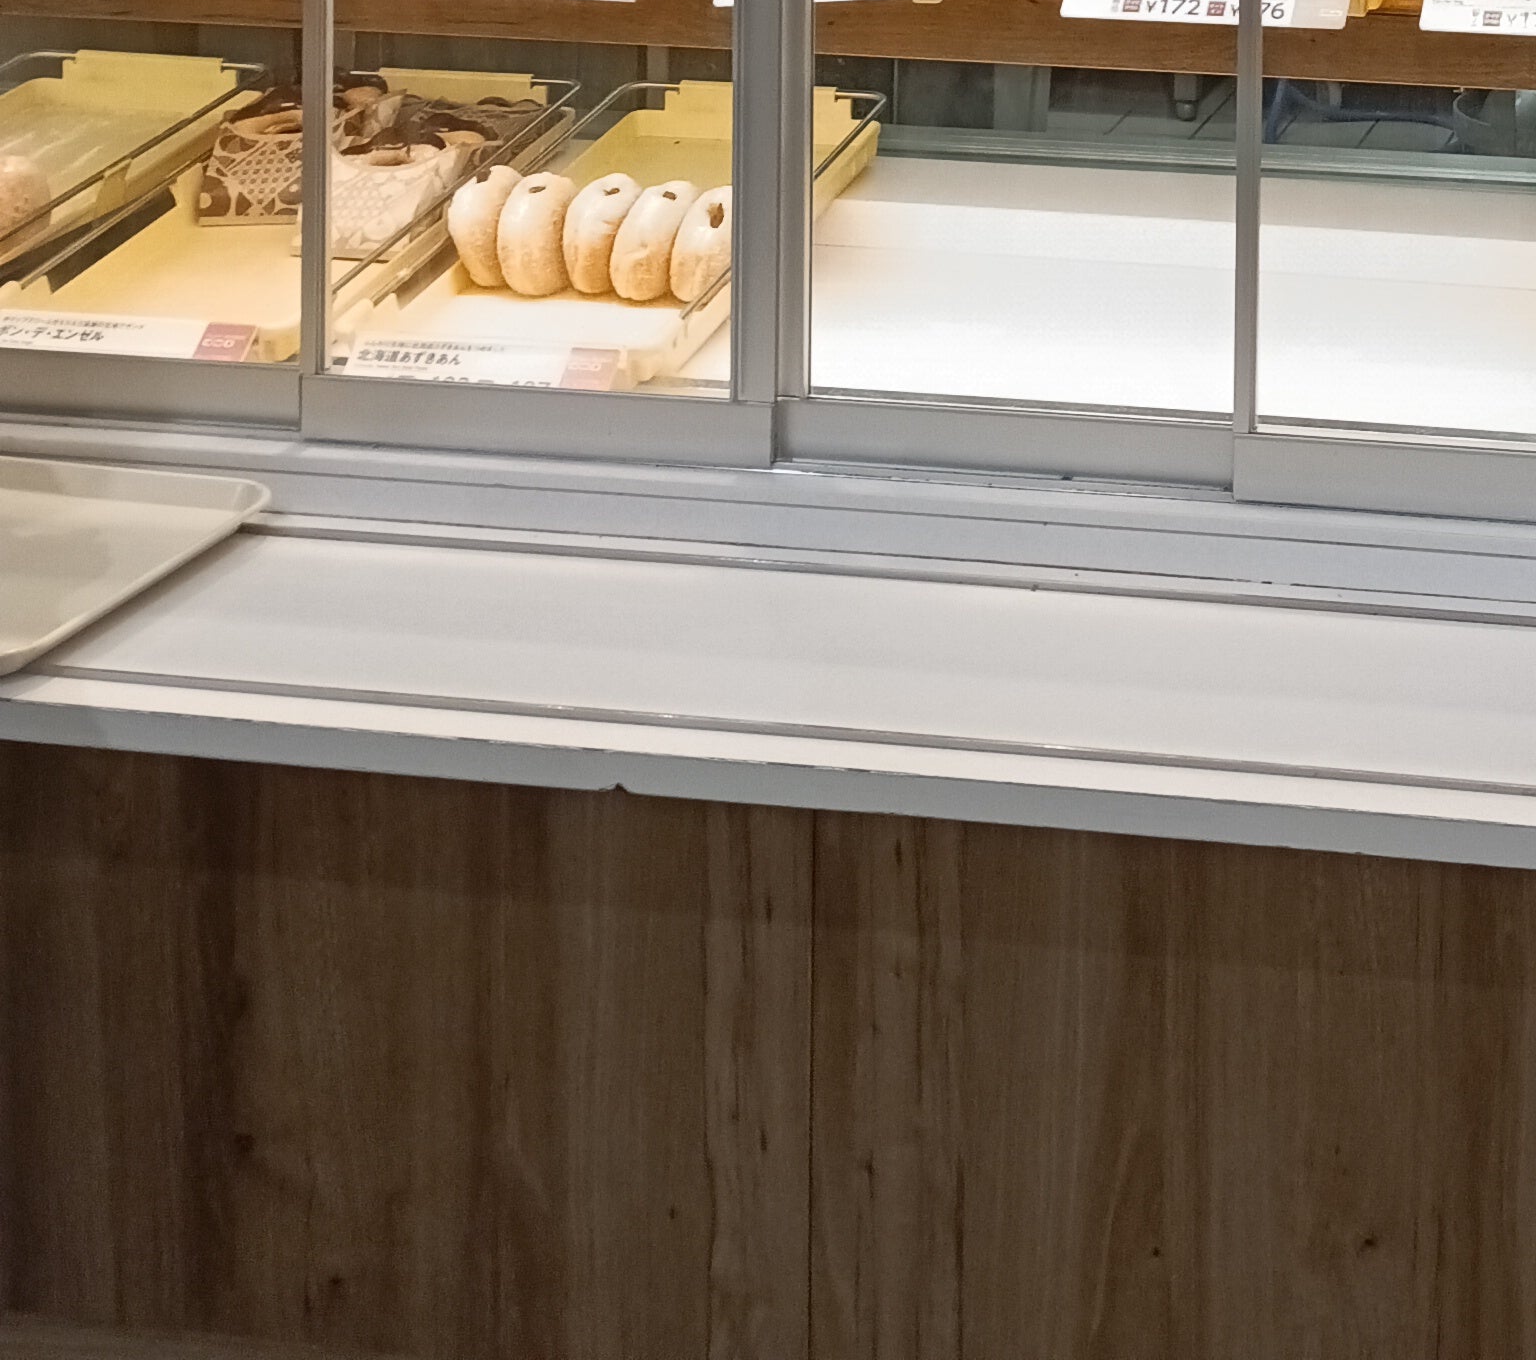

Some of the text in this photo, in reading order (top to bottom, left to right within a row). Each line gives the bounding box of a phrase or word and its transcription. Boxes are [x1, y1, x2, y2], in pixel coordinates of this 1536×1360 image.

[1231, 0, 1285, 20] ¥76
[356, 348, 463, 366] 北海道あずきあん
